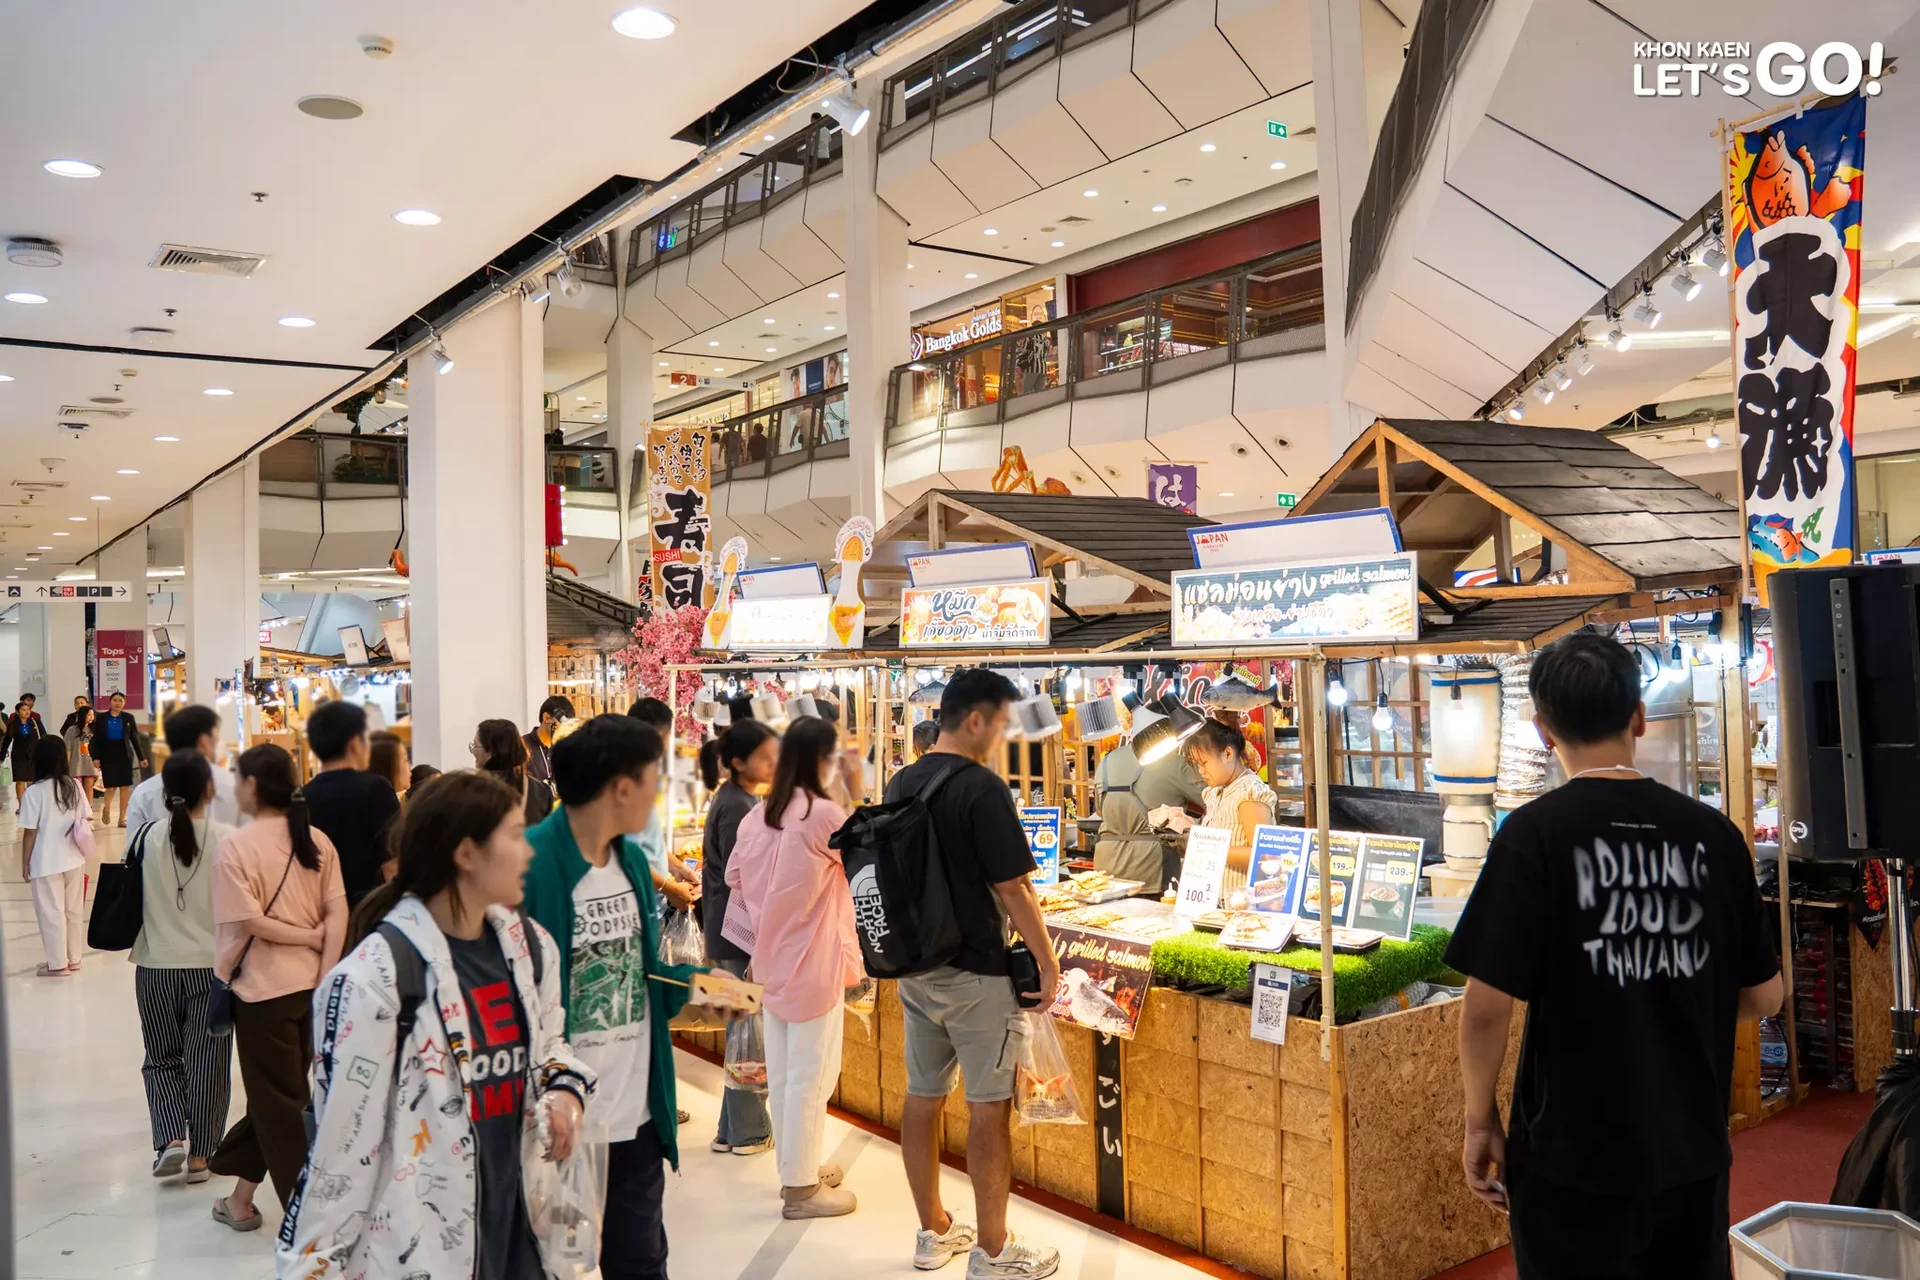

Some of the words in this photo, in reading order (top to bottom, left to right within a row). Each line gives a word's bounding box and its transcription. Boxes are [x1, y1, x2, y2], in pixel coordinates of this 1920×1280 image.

[925, 330, 970, 353] Bangkok
[970, 318, 1002, 340] Golds
[680, 375, 687, 385] 2
[1196, 532, 1229, 545] JAPAN
[654, 551, 681, 563] SUSHI
[1319, 566, 1360, 589] grilled
[1362, 565, 1412, 583] salmon
[931, 589, 977, 622] หมึก
[101, 647, 124, 656] Tops
[1039, 833, 1053, 844] 69
[587, 898, 629, 918] GREEN
[869, 895, 891, 938] FACE
[1600, 889, 1704, 934] LOUD
[859, 896, 884, 954] NORTH
[1066, 939, 1109, 961] grilled
[1107, 946, 1152, 971] salmon
[1583, 934, 1710, 988] THAILAND
